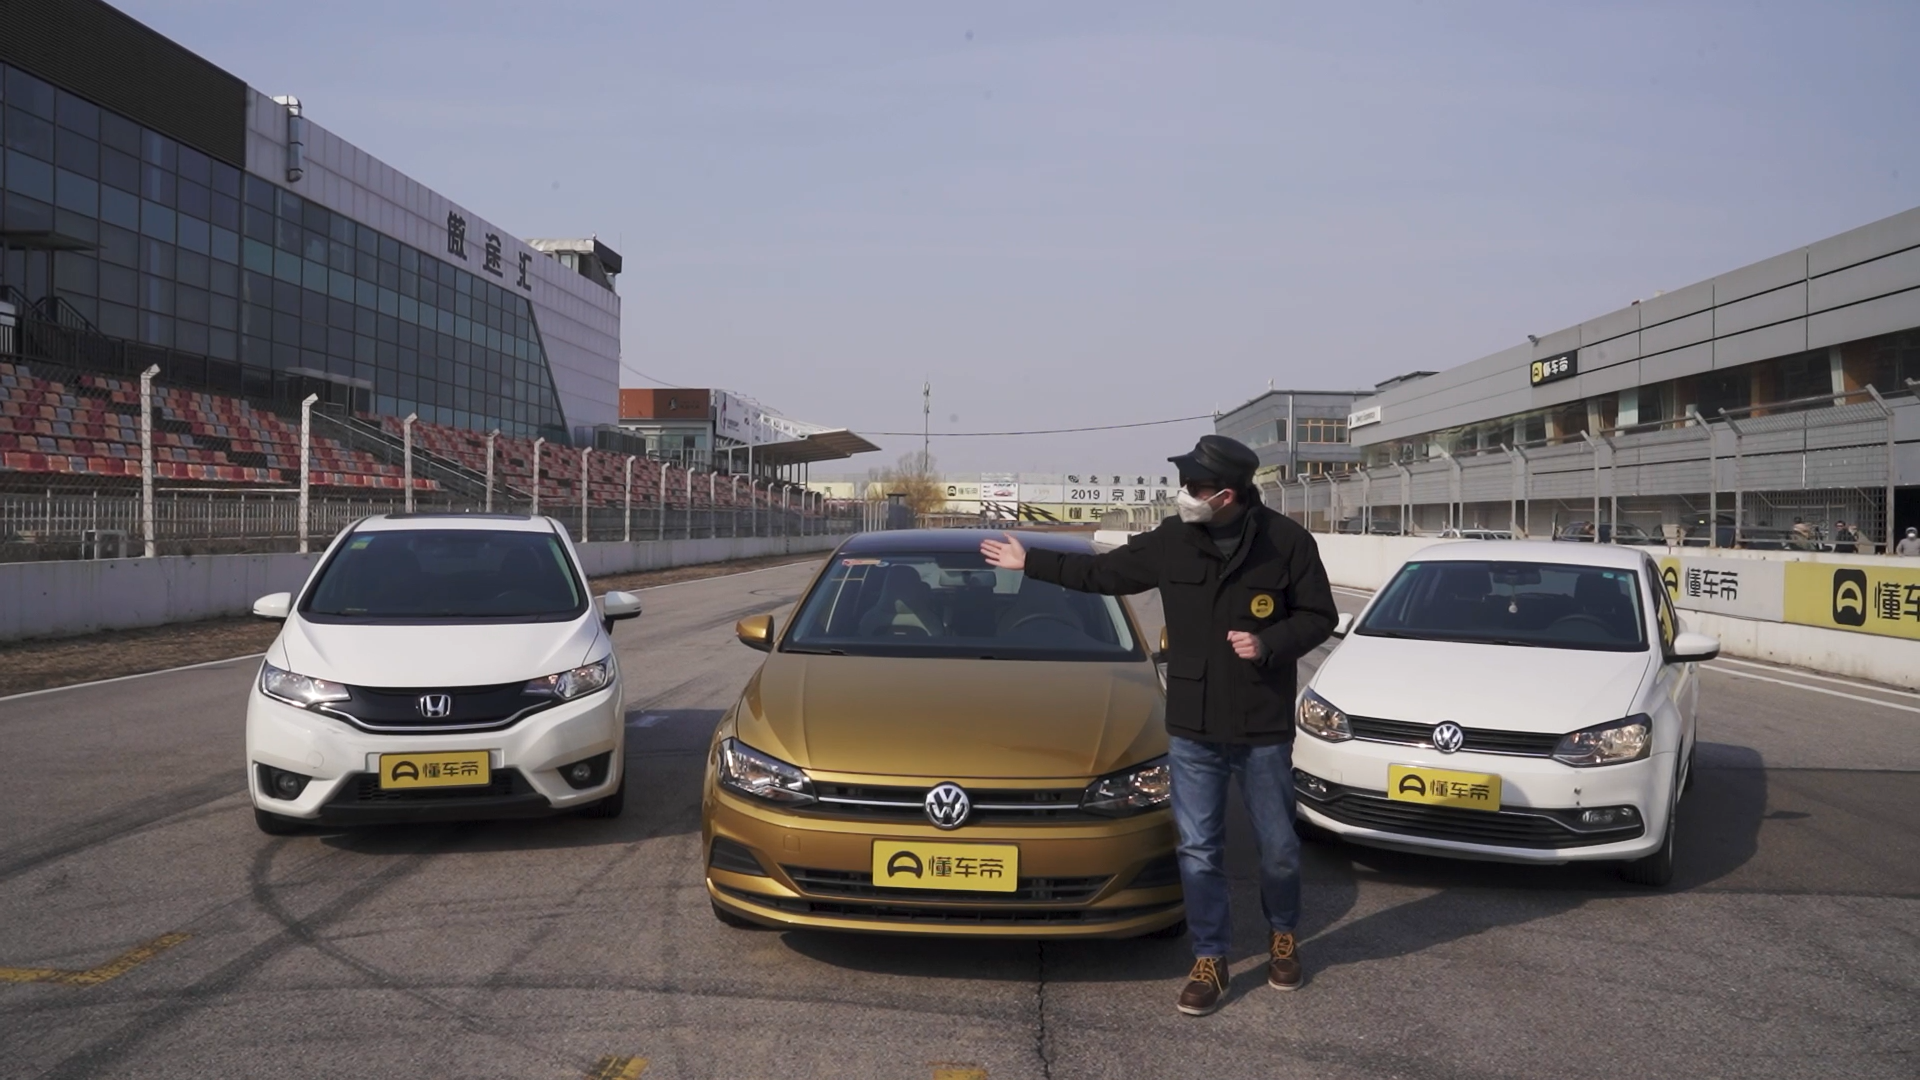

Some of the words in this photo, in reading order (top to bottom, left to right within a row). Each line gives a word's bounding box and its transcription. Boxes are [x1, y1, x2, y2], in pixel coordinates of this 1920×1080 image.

[1071, 489, 1100, 500] 2019
[1685, 566, 1738, 601] 懂车帝
[422, 761, 479, 778] 懂车帝
[1430, 779, 1490, 800] 懂车帝
[928, 855, 1004, 879] 懂车帝
